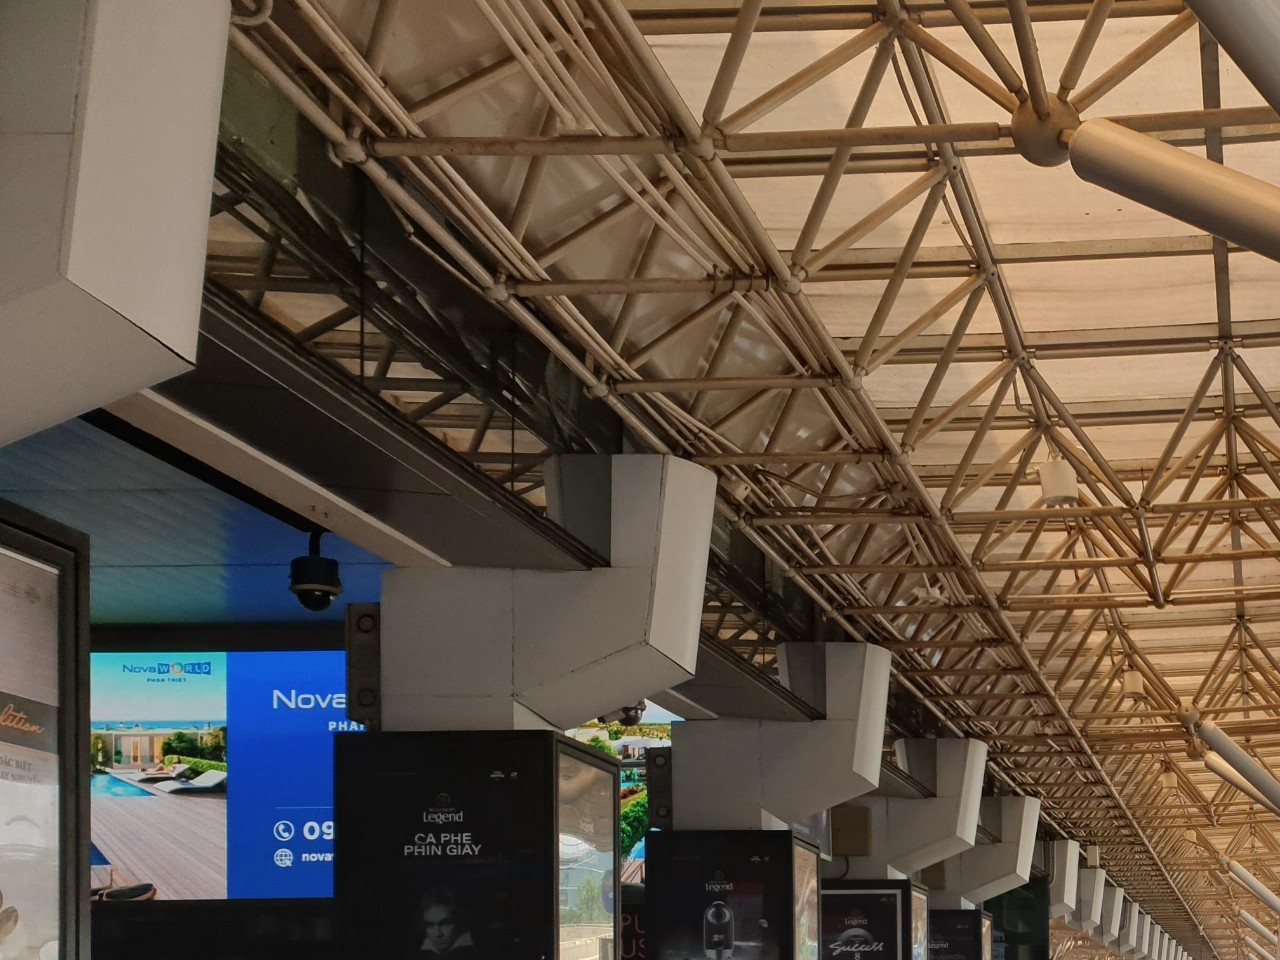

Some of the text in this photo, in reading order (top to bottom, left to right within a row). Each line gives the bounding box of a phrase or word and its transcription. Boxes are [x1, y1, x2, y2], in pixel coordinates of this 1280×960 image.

[423, 811, 463, 825] Legend
[404, 845, 442, 856] PHIN
[302, 852, 334, 862] nova
[706, 883, 733, 892] Legend
